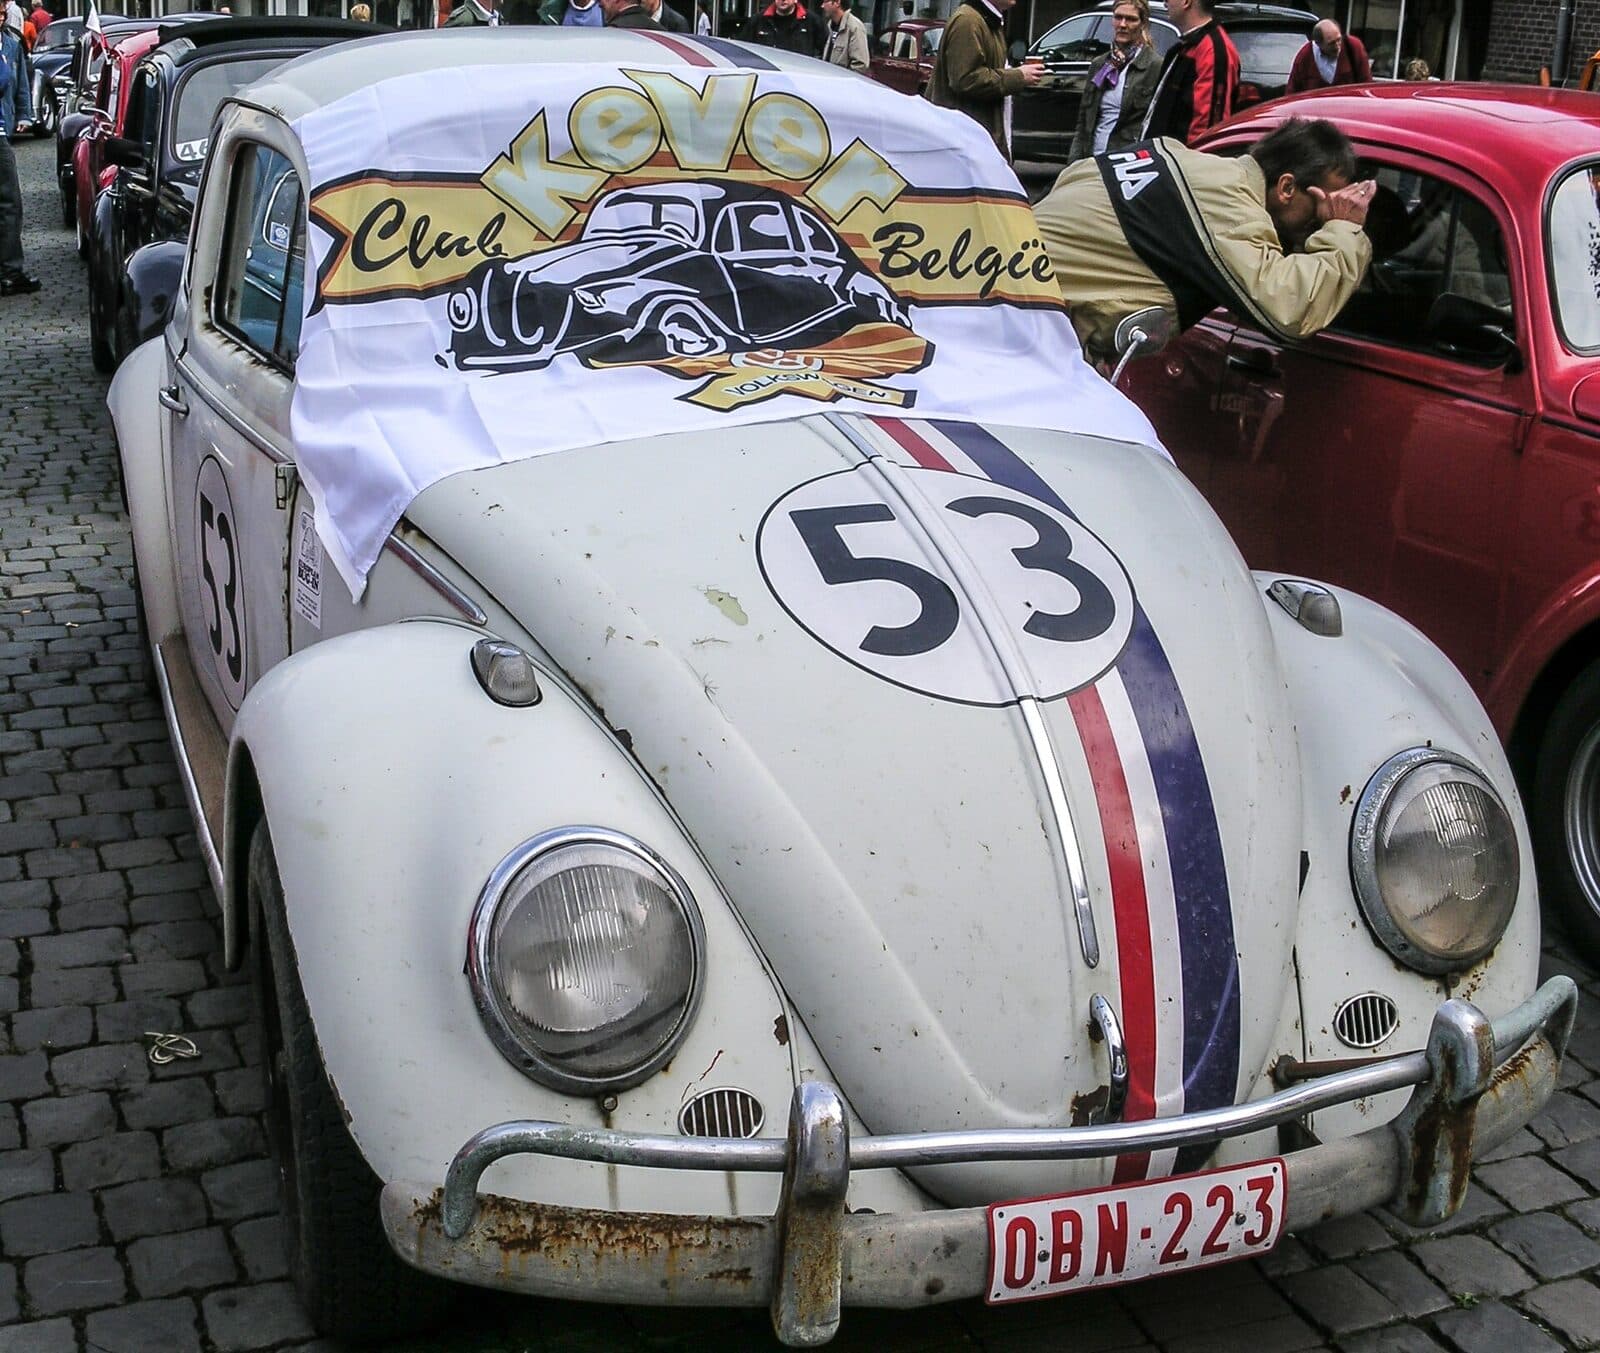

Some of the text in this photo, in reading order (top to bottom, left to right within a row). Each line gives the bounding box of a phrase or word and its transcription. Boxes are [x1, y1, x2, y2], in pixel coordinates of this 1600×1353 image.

[1107, 149, 1160, 201] FILA
[351, 198, 1054, 298] Club België
[725, 372, 886, 398] VOLKSWGEN
[200, 491, 242, 683] 53
[788, 496, 1116, 657] 53
[1003, 1176, 1275, 1289] OBN-223
